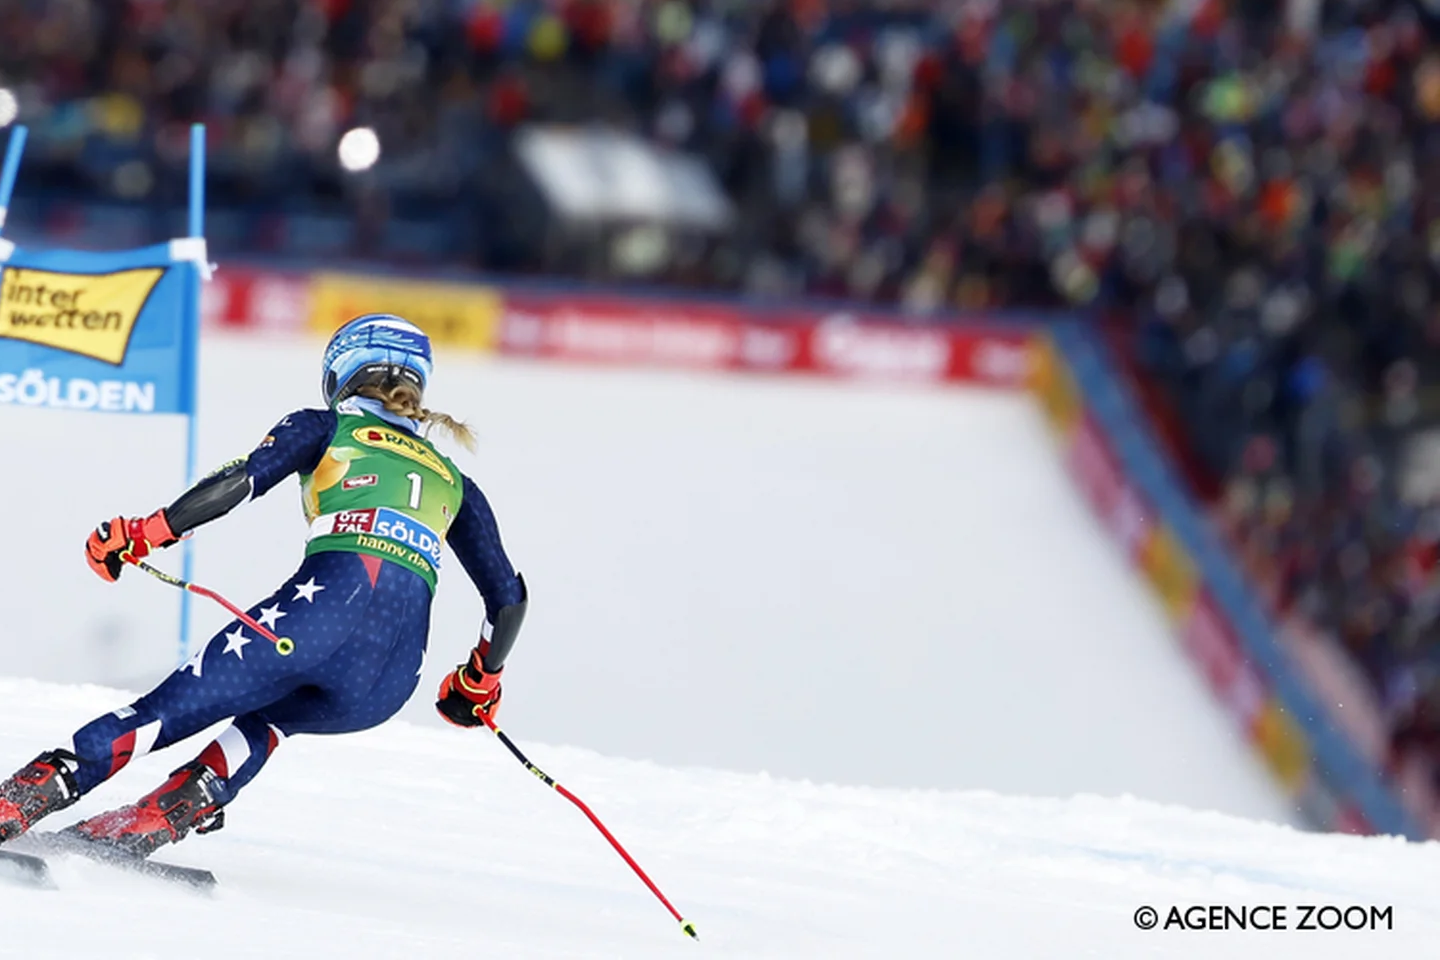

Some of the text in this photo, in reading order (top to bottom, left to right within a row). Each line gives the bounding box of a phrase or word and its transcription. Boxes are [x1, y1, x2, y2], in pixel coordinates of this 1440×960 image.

[7, 267, 84, 308] inter
[10, 310, 122, 331] wetten
[406, 472, 422, 510] 1
